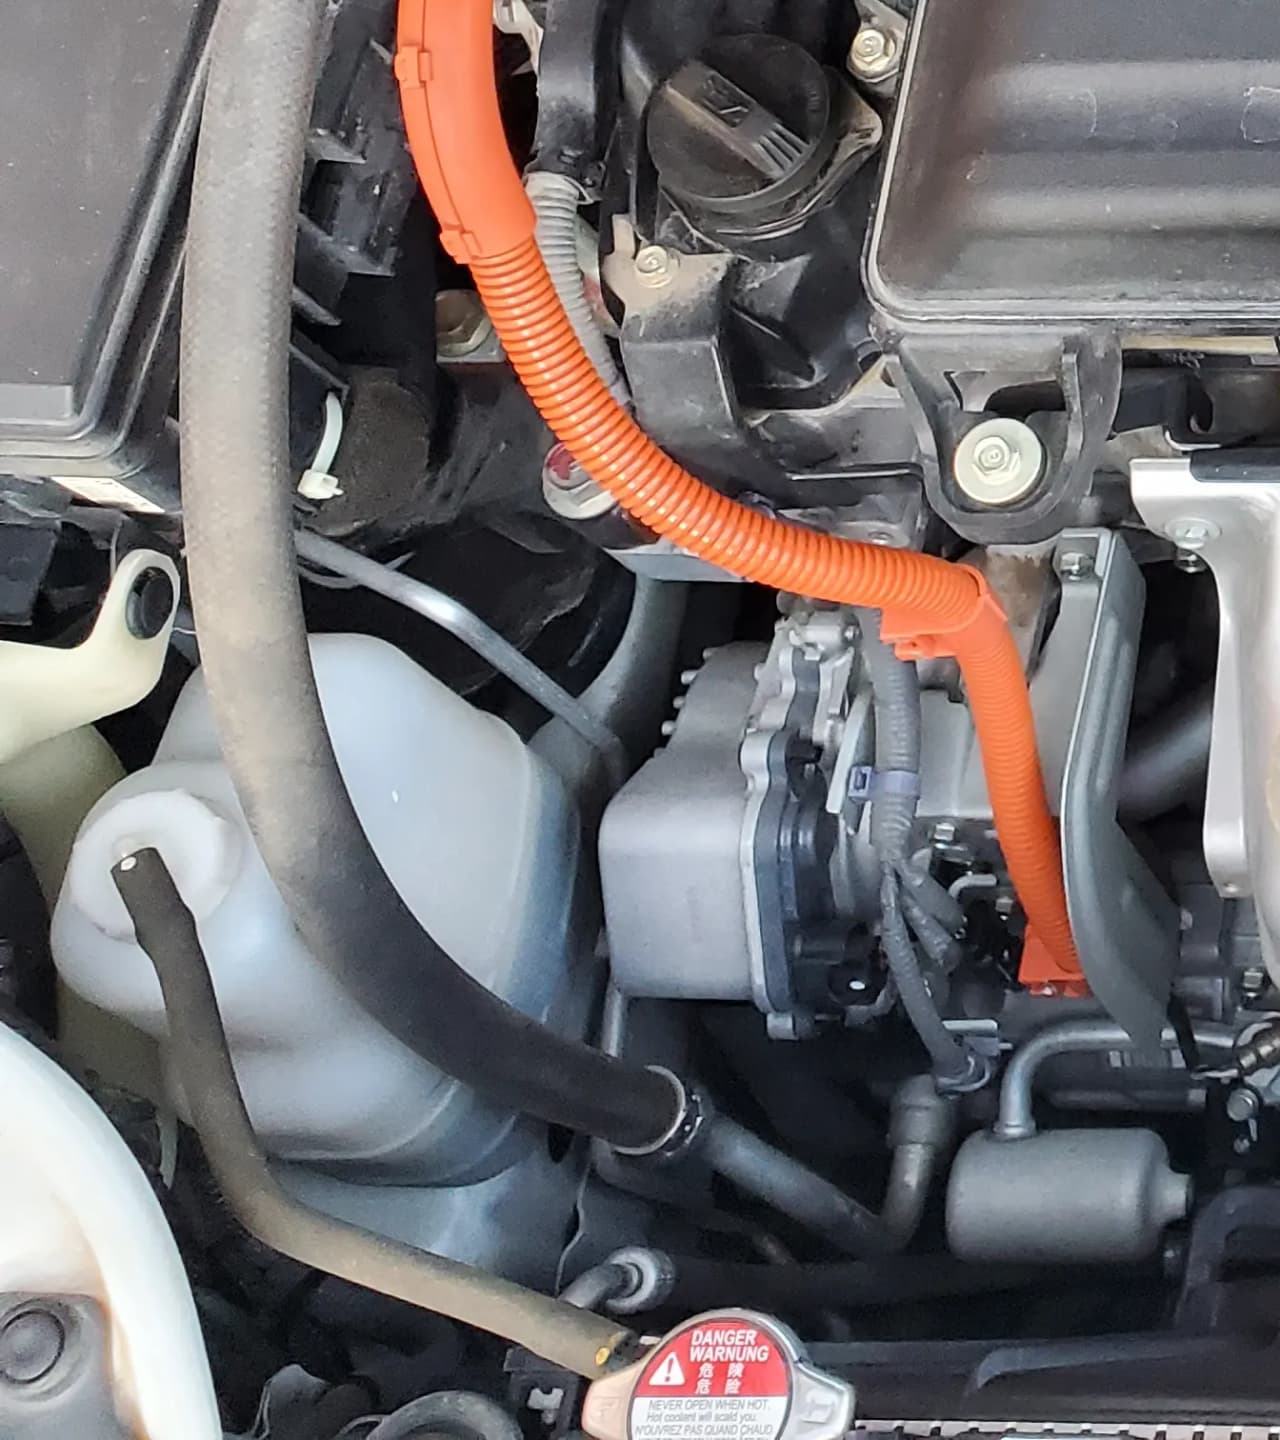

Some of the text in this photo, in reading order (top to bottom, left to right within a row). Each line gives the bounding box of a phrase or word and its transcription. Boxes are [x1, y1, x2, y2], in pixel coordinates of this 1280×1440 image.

[691, 1329, 757, 1346] DANGER
[689, 1345, 769, 1362] WARNUNG
[649, 1399, 682, 1410] NEVER
[684, 1399, 713, 1410] OPEN
[715, 1399, 745, 1409] WHEN
[647, 1412, 662, 1422] Hot
[714, 1412, 737, 1422] scald
[684, 1425, 702, 1435] PAS
[705, 1425, 738, 1436] QUAND
